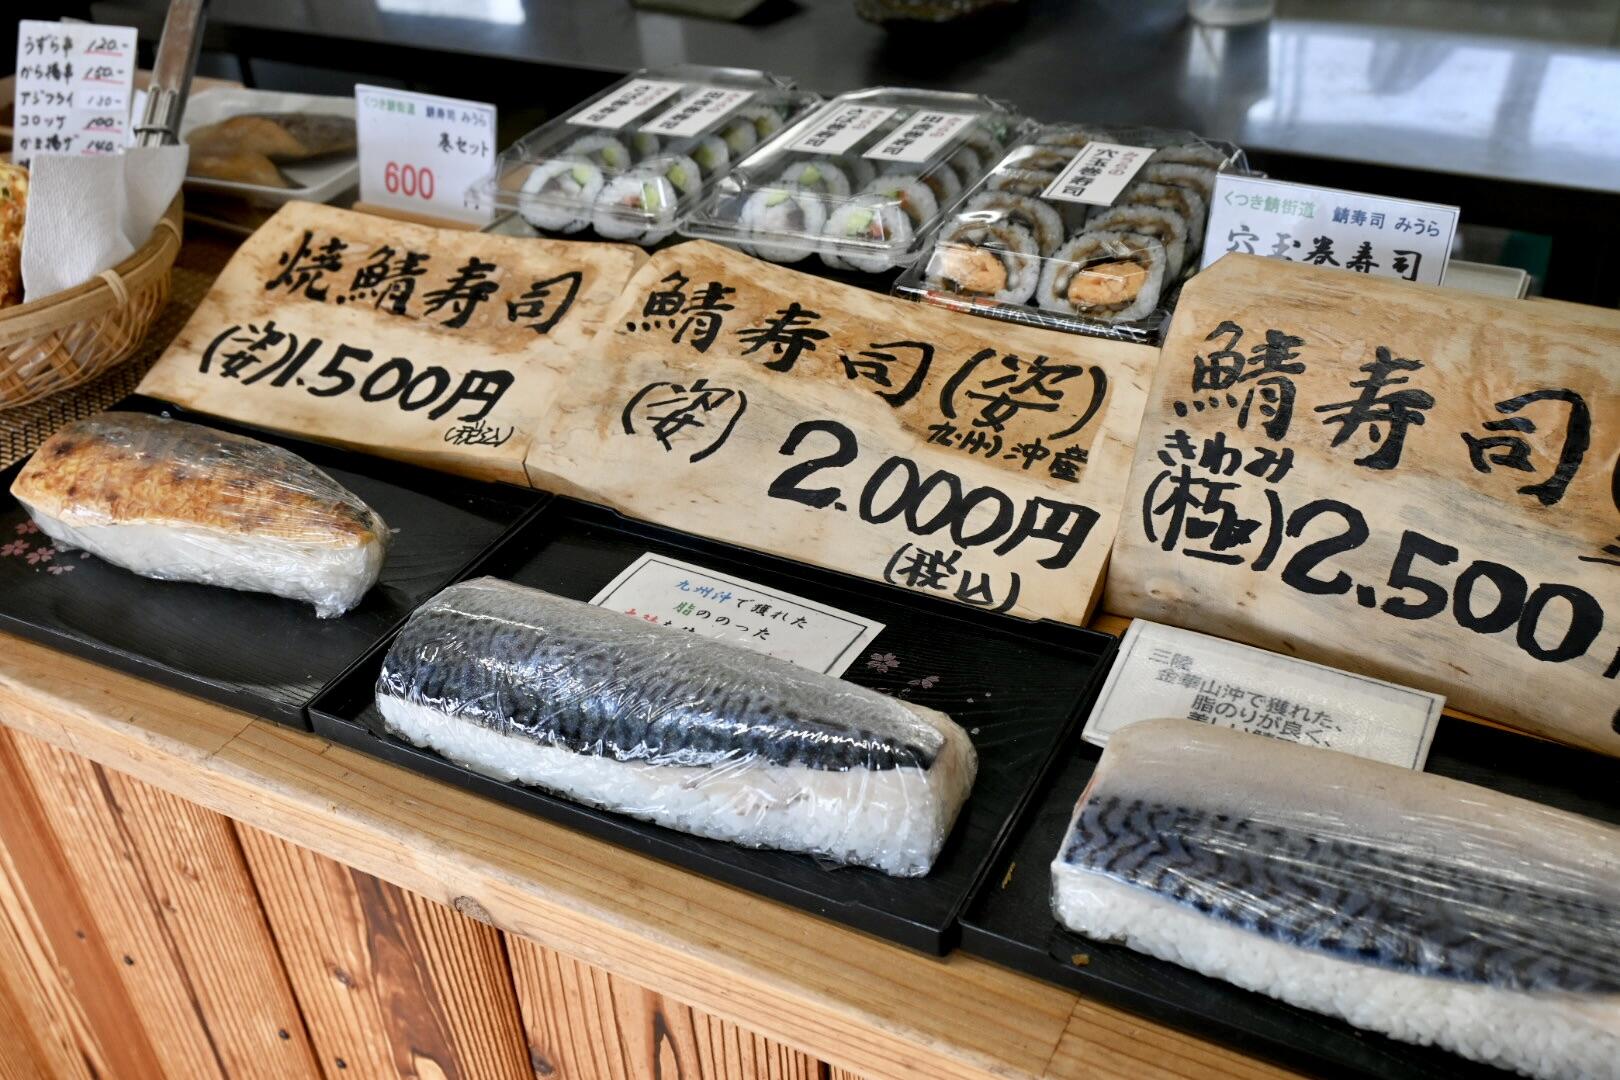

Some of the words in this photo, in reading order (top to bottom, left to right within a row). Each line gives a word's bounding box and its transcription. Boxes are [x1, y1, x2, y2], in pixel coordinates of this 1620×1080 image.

[20, 90, 74, 108] アジフライ
[20, 114, 66, 130] コロッケ
[384, 161, 435, 200] 600
[1224, 191, 1316, 219] くつき鯖街道
[1331, 205, 1387, 231] 鯖寿司
[1394, 217, 1441, 239] みうら
[266, 230, 583, 334] 焼鯖寿司
[621, 378, 748, 464] (姿)
[1174, 320, 1593, 506] 鯖寿司
[927, 421, 1091, 484] 九州沖産
[1157, 429, 1295, 484] きわみ
[675, 579, 808, 630] 九州沖で獲れた
[883, 542, 1021, 614] (税込)
[672, 601, 771, 641] 脂ののった
